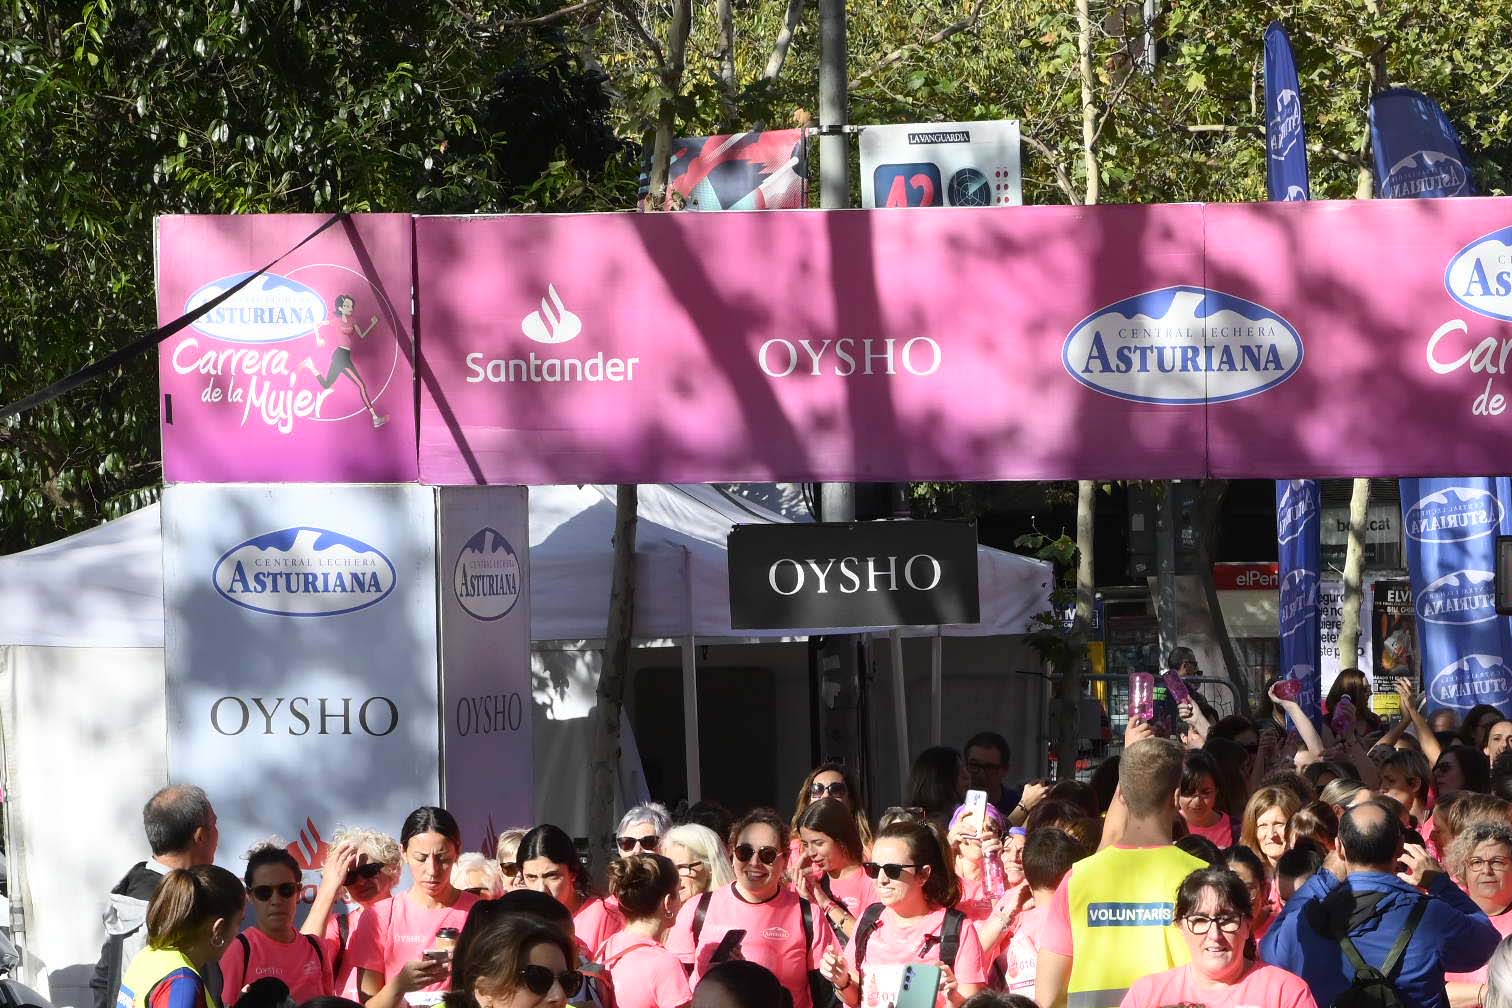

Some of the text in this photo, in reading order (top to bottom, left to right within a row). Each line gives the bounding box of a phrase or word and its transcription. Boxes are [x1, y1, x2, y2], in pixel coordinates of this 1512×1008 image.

[920, 132, 969, 143] VANGUARDIA
[1118, 324, 1277, 340] CENTRAL LECHERA
[172, 338, 289, 376] Carrera
[466, 351, 639, 383] Santander
[758, 336, 942, 378] OYSHO
[1081, 331, 1285, 374] ASTURIANA
[201, 373, 333, 434] de la Mujer
[1472, 377, 1506, 416] de
[227, 560, 382, 594] ASTURIANA
[255, 558, 313, 568] CENTRAL
[769, 553, 942, 596] OYSHO
[459, 564, 517, 598] ASTURIANA
[1387, 590, 1412, 602] ELVI
[210, 696, 399, 736] OYSHO
[457, 693, 522, 737] OYSHO
[1089, 908, 1171, 922] VOLUNTARIS
[882, 990, 896, 1001] 01
